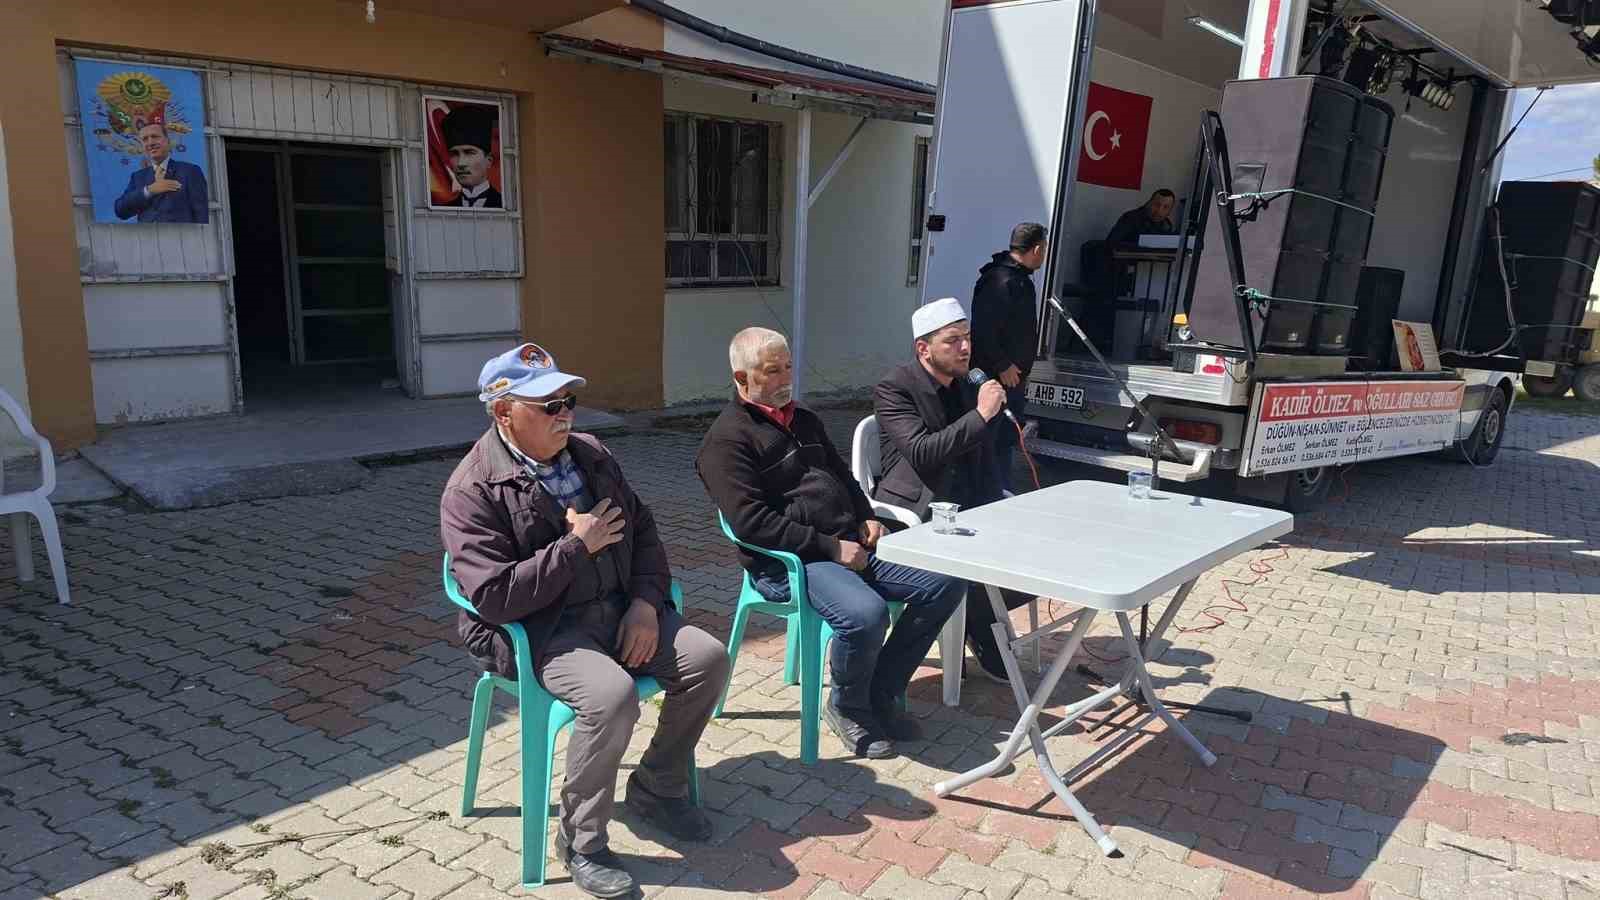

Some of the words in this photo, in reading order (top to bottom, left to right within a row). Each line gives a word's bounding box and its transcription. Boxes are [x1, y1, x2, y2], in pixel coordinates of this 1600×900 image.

[1035, 385, 1055, 400] AHB
[1061, 388, 1082, 405] 592
[1270, 388, 1312, 417] KADİR
[1313, 388, 1352, 415] ÖLMEZ
[1365, 387, 1410, 410] OĞULLARI
[1261, 445, 1276, 455] Erkan
[1276, 442, 1296, 452] ÖLMEZ
[1321, 437, 1338, 448] ÖLMEZ
